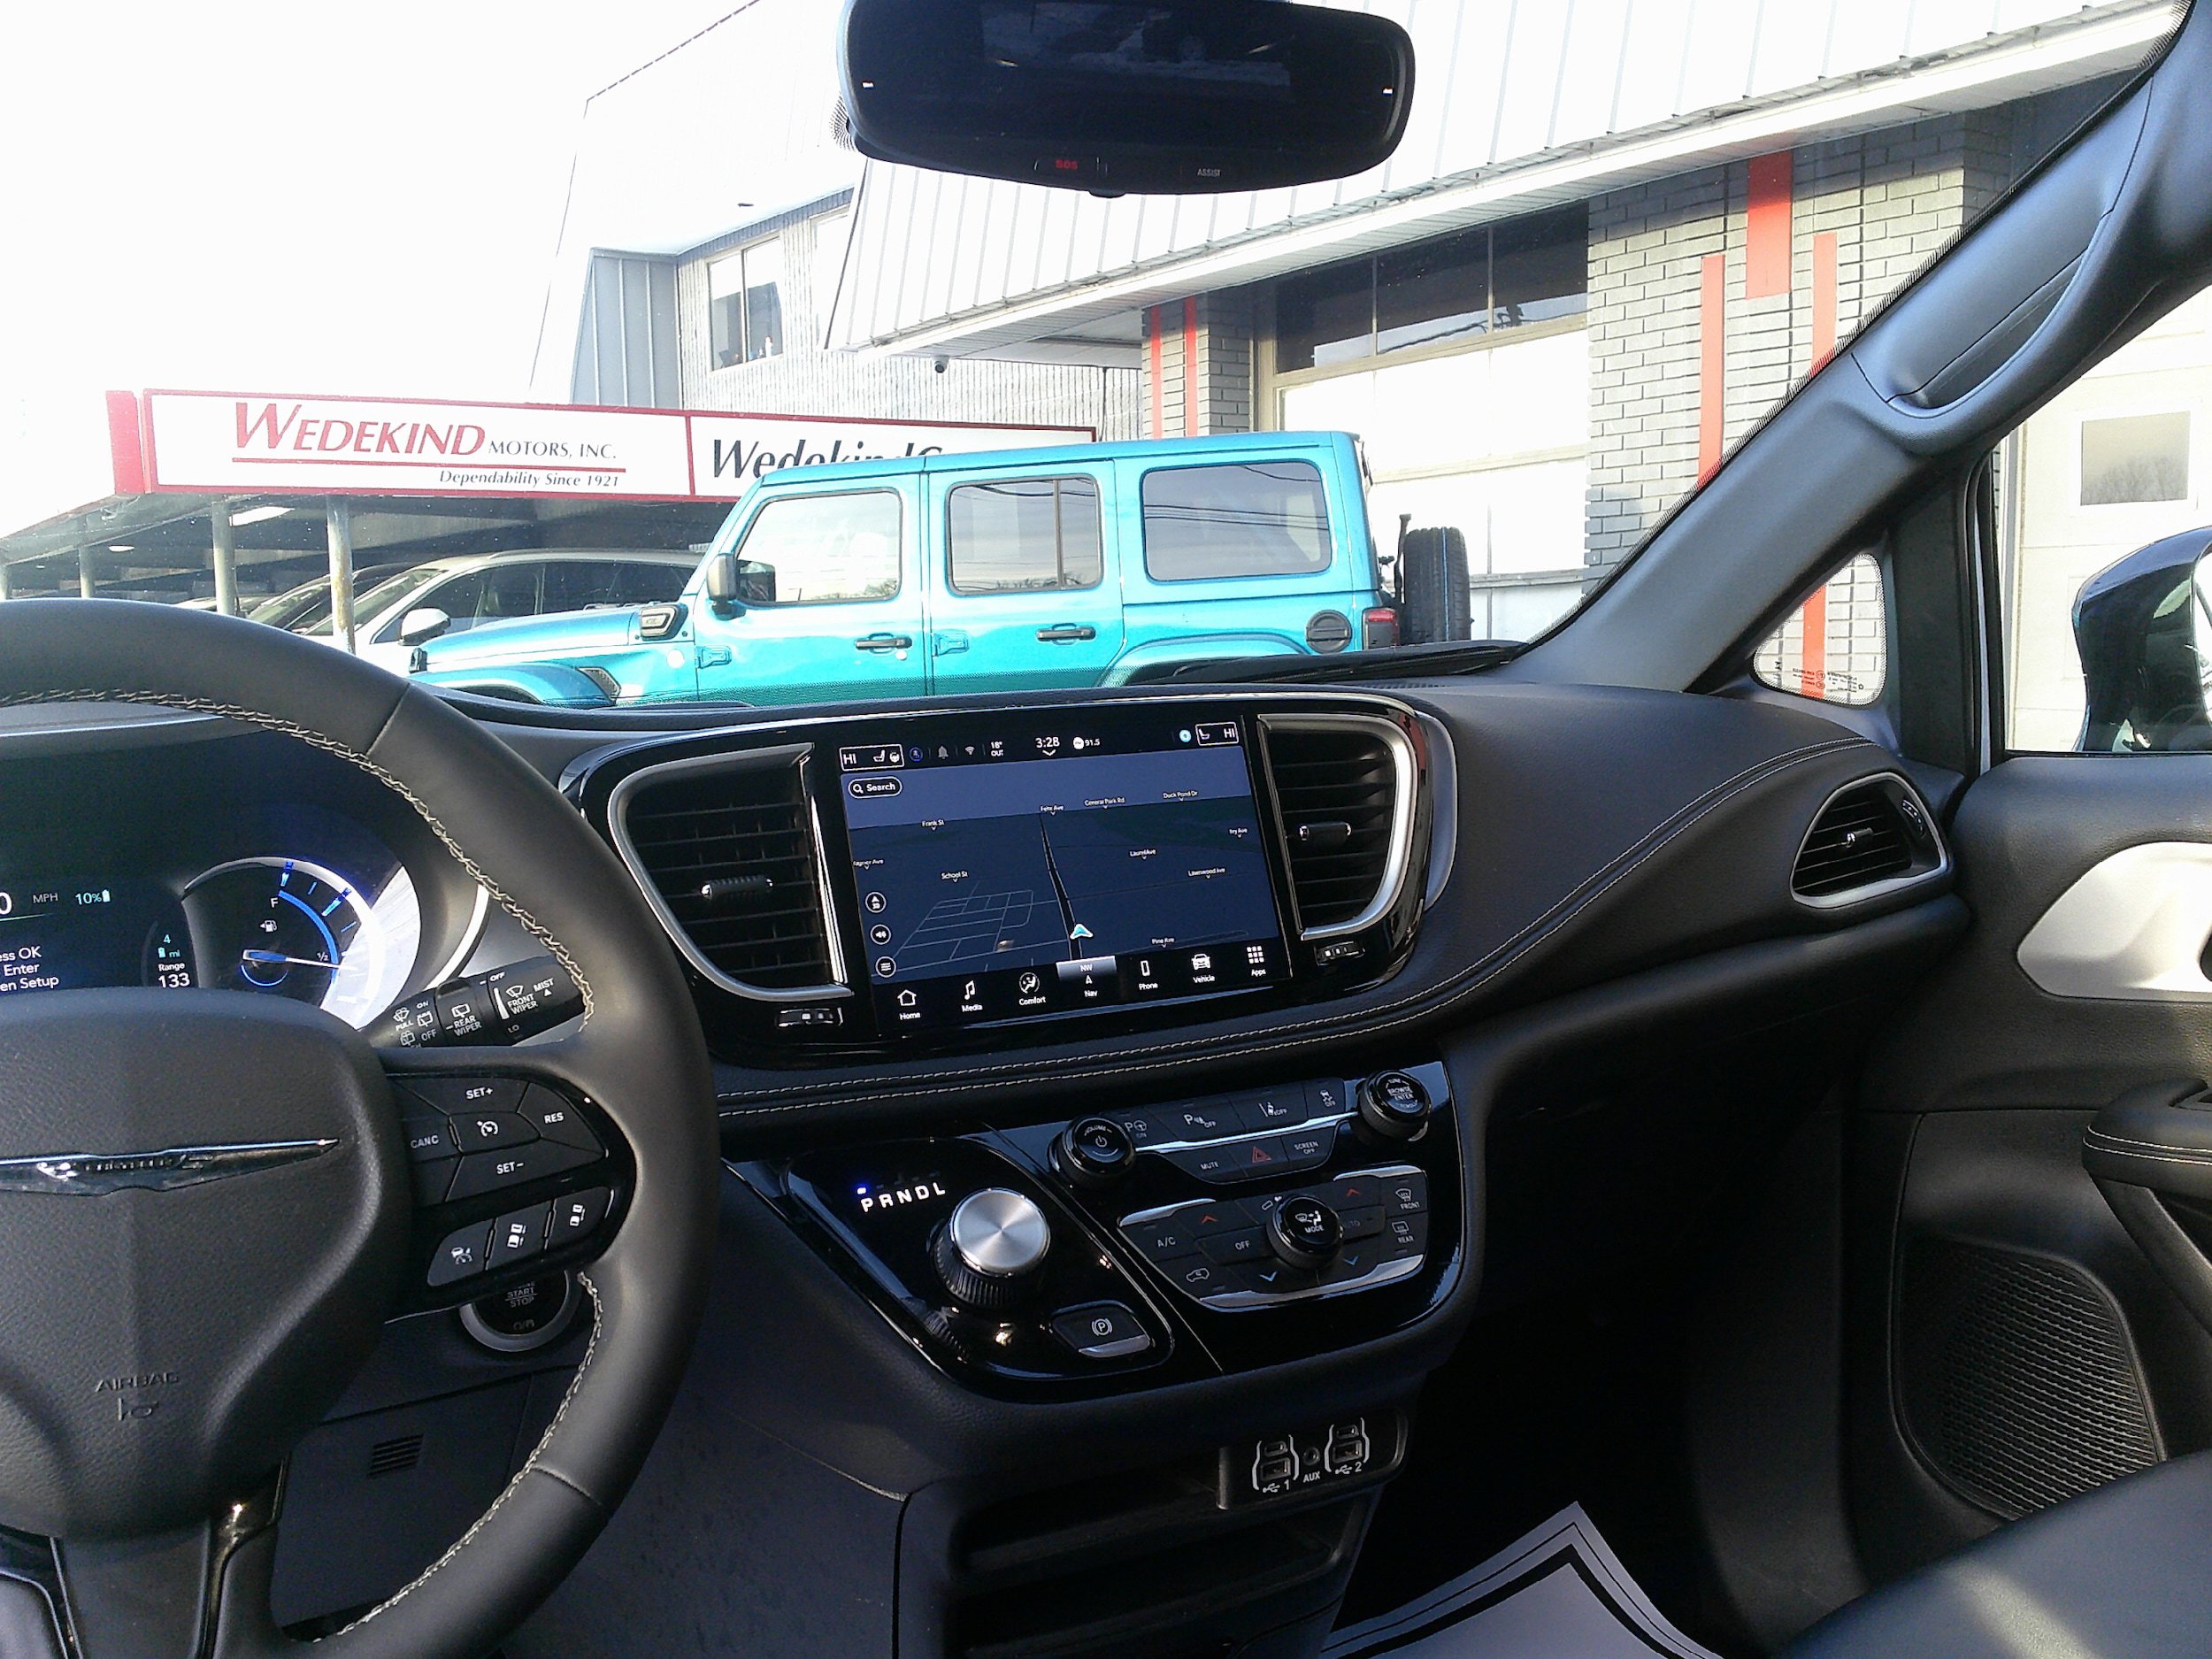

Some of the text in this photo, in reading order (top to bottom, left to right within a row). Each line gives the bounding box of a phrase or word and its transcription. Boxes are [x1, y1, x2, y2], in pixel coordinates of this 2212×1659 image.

[1197, 168, 1230, 177] ASSIST
[235, 402, 617, 458] WEDEKIND MOTORS, INC.
[440, 470, 618, 488] Dependability Since 1921
[1035, 737, 1060, 749] 3:28
[1085, 738, 1101, 747] 91.5
[843, 753, 856, 764] HI
[866, 782, 896, 792] Search
[33, 893, 59, 903] MPH
[75, 892, 102, 906] 10%
[270, 897, 279, 908] F
[163, 933, 172, 944] 4
[18, 946, 42, 960] OK
[4, 964, 40, 977] Enter
[157, 962, 185, 972] Range
[1251, 968, 1266, 977] Apps
[19, 977, 59, 990] Setup
[157, 972, 190, 988] 133
[533, 978, 555, 992] MIST
[1193, 974, 1216, 984] Vehicle
[1139, 981, 1158, 991] Phone
[1084, 989, 1098, 998] Nav
[507, 993, 534, 1008] FRONT
[1018, 996, 1047, 1006] Comfort
[511, 1000, 538, 1015] WIPER
[962, 1003, 983, 1012] Media
[454, 1015, 476, 1029] REAR
[899, 1011, 921, 1021] Home
[420, 1028, 437, 1041] OFF
[454, 1021, 482, 1037] WIPER
[465, 1087, 494, 1100] SET+
[544, 1111, 565, 1124] RES
[411, 1134, 439, 1148] CANC
[1304, 1224, 1324, 1233] MODE
[1156, 1236, 1176, 1248] A/C
[1235, 1240, 1250, 1250] OFF
[507, 1287, 534, 1299] START
[1355, 1461, 1363, 1472] 2
[1302, 1471, 1321, 1483] AUX
[1284, 1479, 1290, 1491] 1
